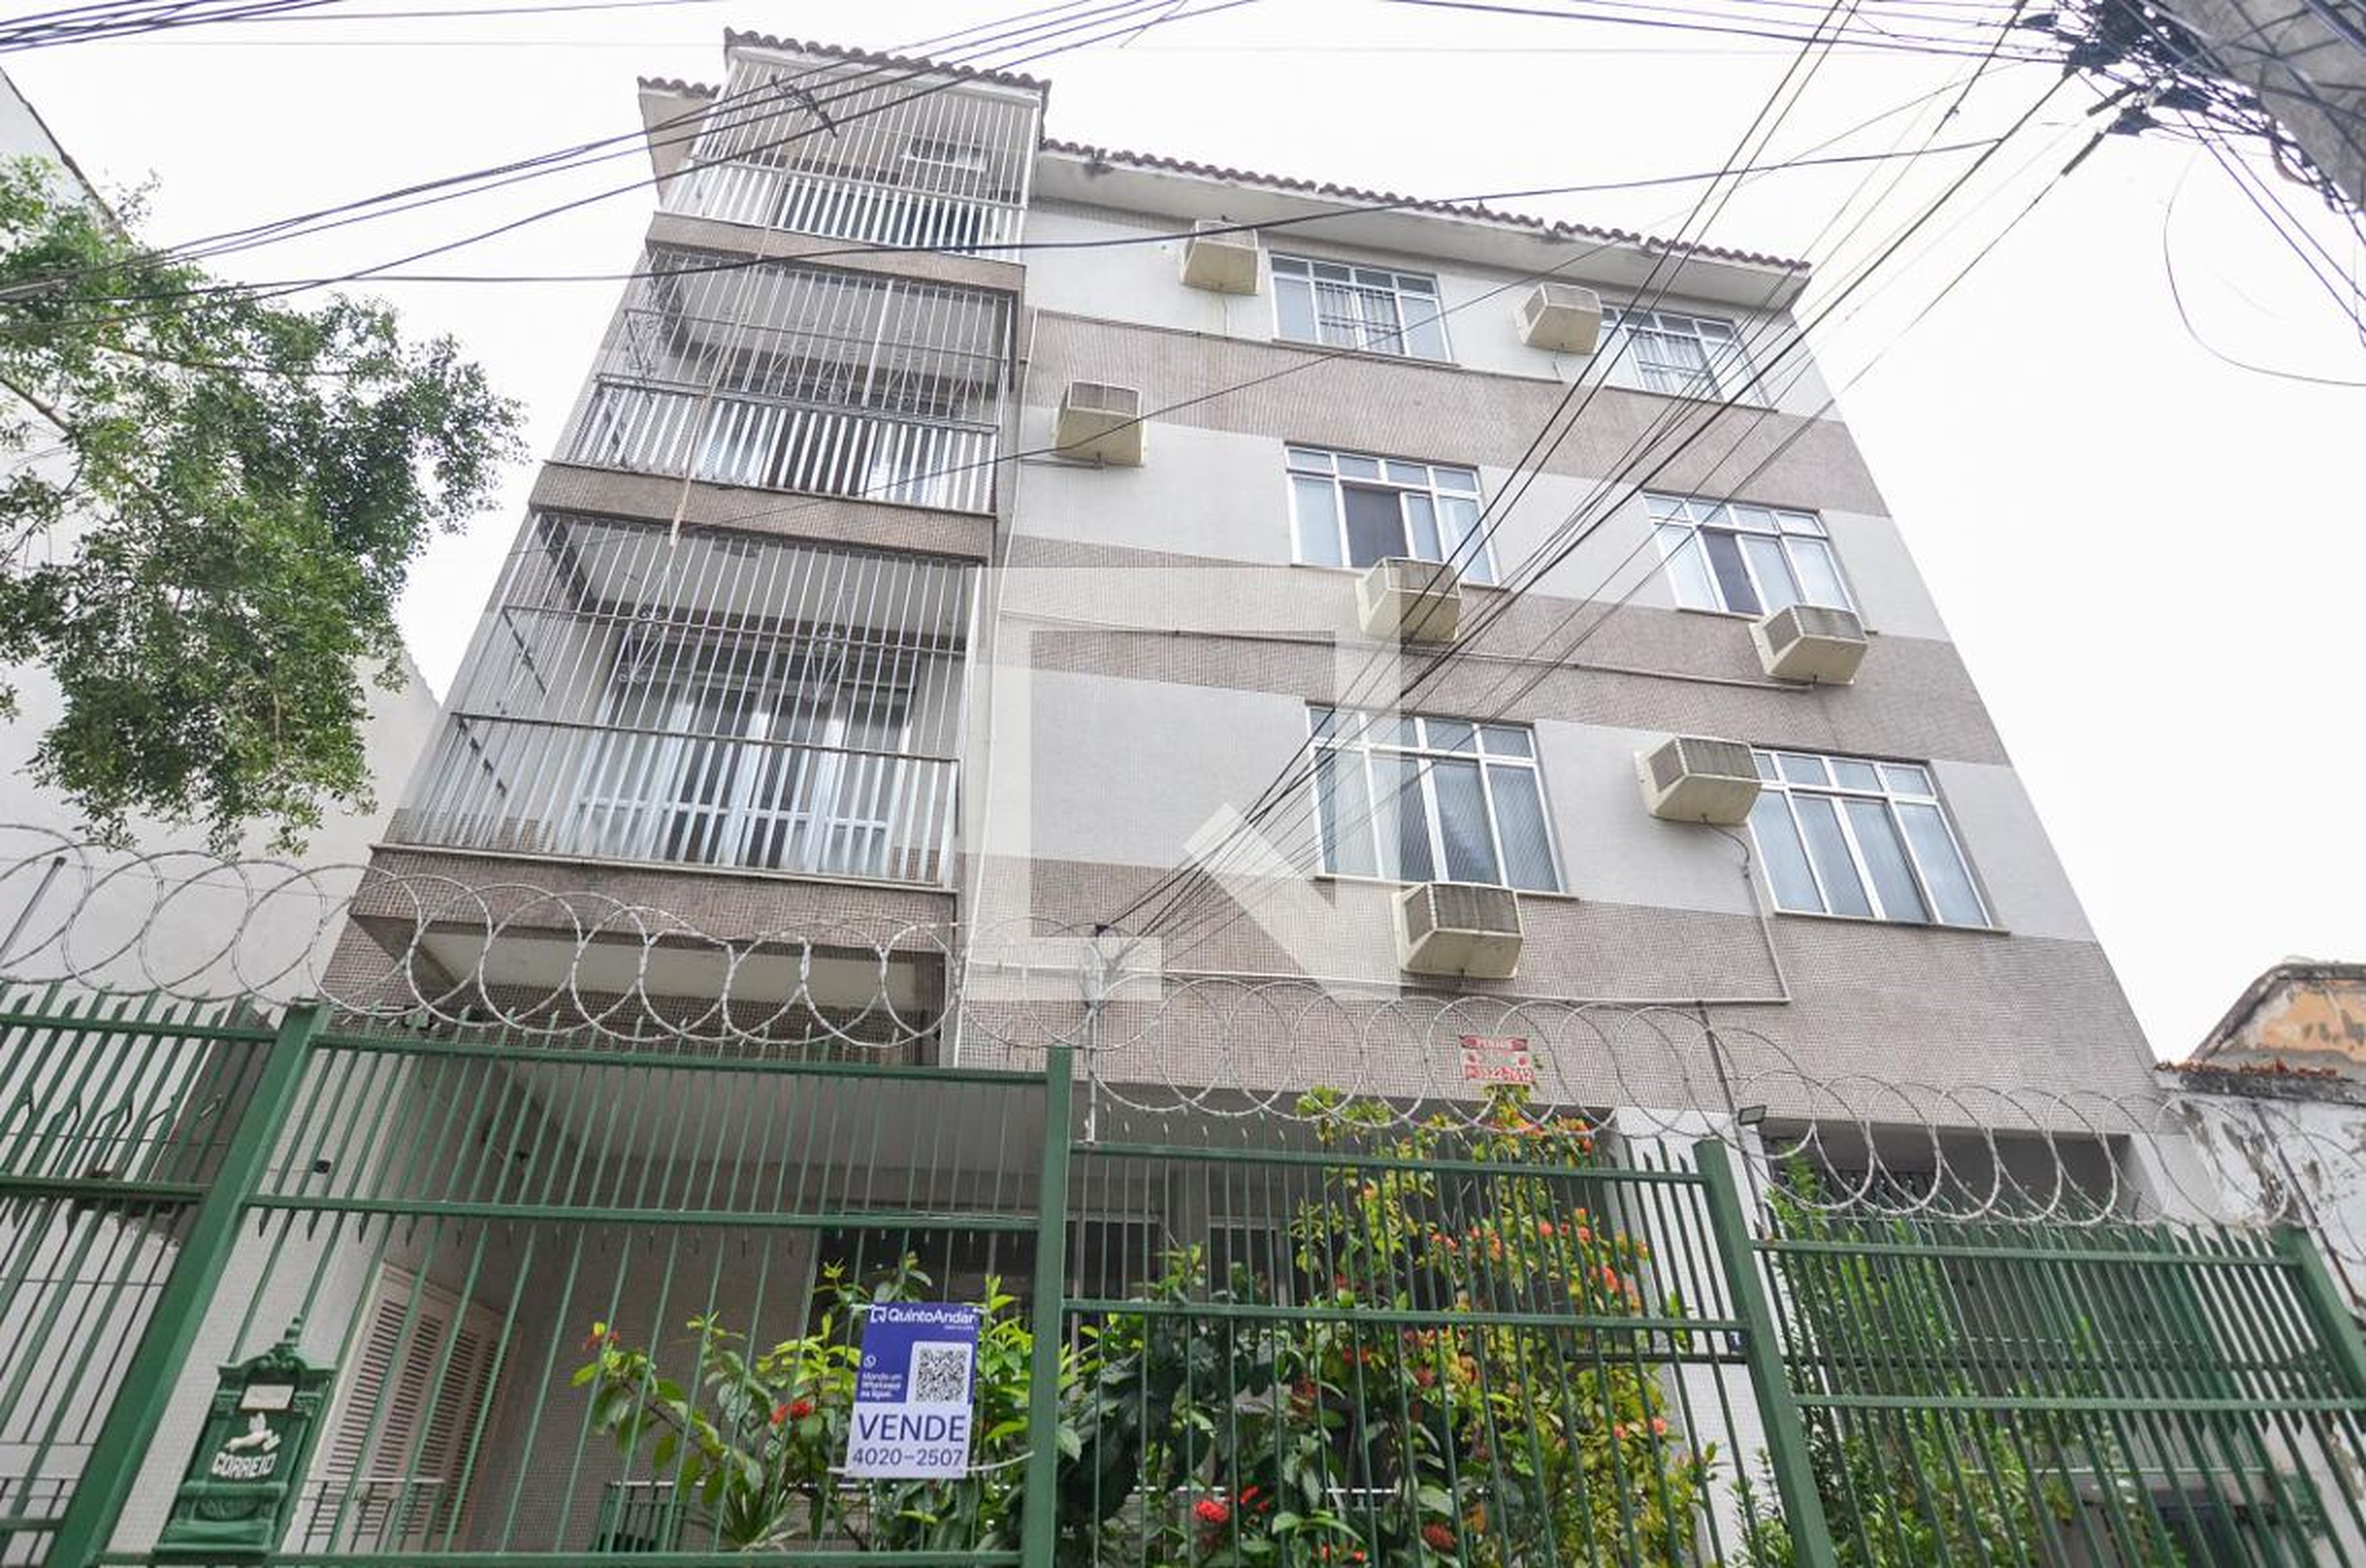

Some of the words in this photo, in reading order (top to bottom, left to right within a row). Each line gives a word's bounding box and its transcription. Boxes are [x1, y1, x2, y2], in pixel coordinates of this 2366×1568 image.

[888, 1307, 976, 1324] QuintoAndar
[859, 1413, 966, 1442] VENDE
[212, 1452, 278, 1479] CORREIO
[853, 1447, 963, 1466] 4020-2507
